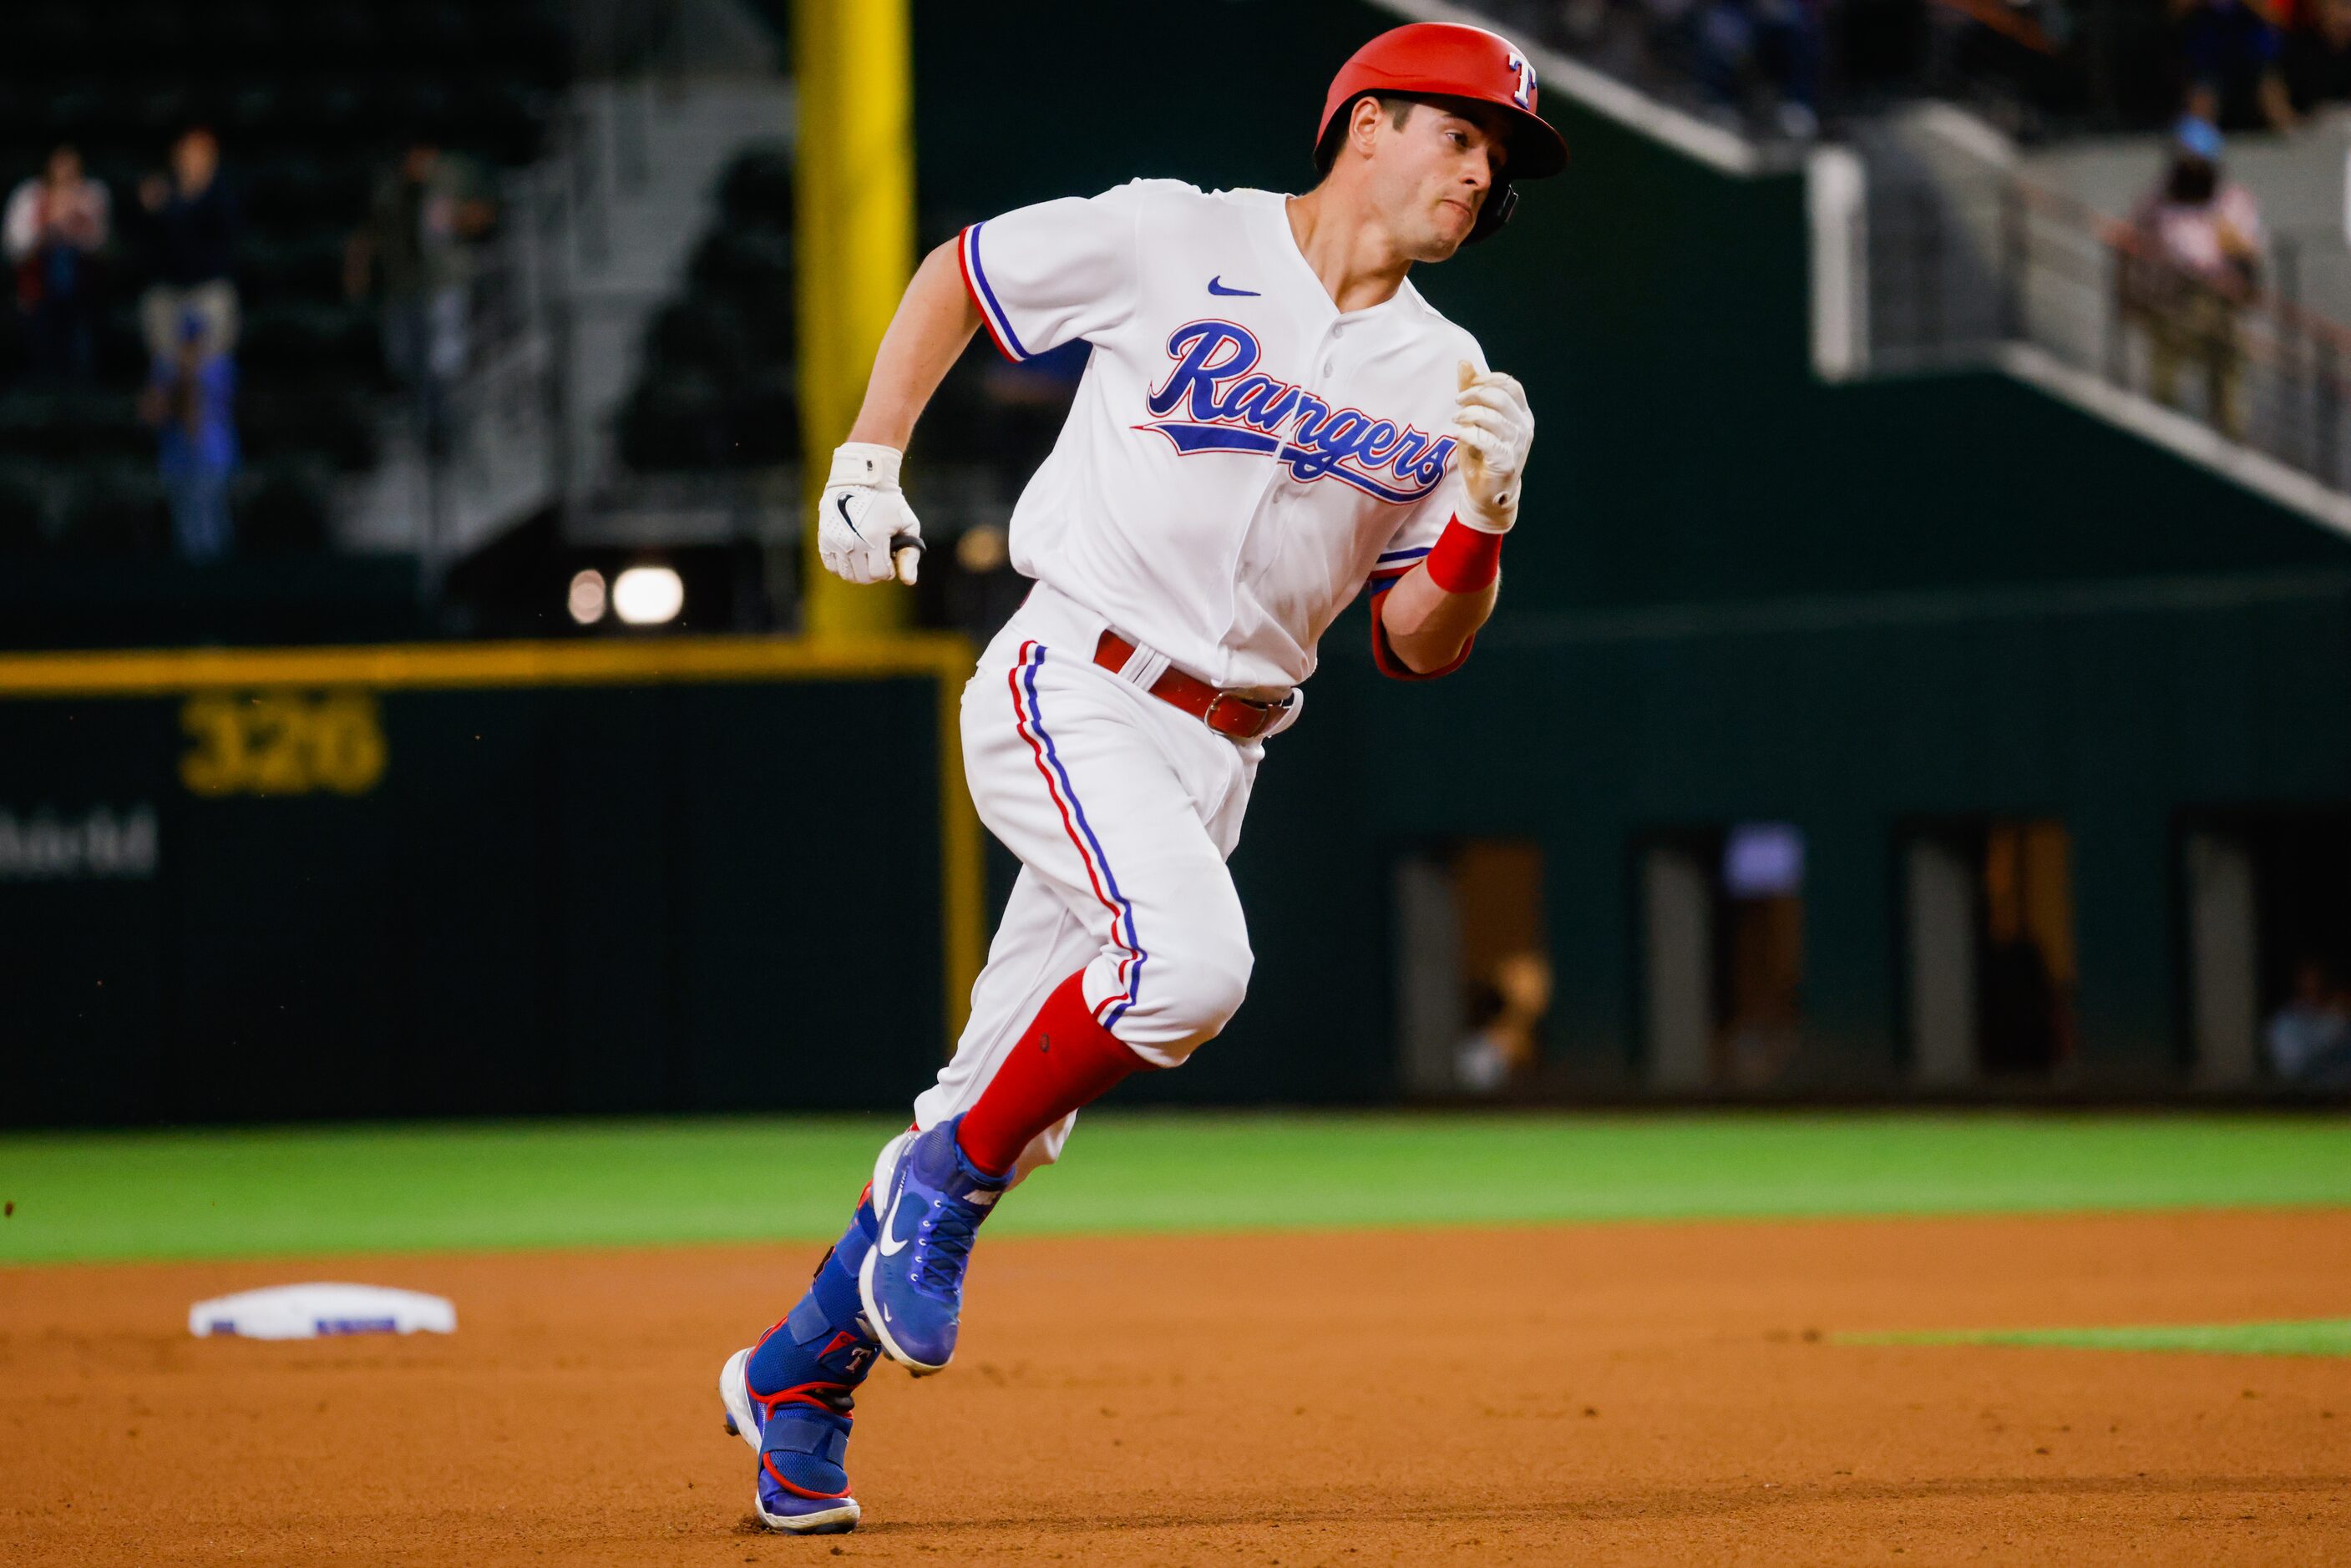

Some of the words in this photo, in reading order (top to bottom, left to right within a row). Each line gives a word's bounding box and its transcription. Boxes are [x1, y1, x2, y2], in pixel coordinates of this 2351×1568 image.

[1508, 51, 1537, 110] T
[1141, 318, 1457, 501] Rangers
[180, 695, 385, 796] 326
